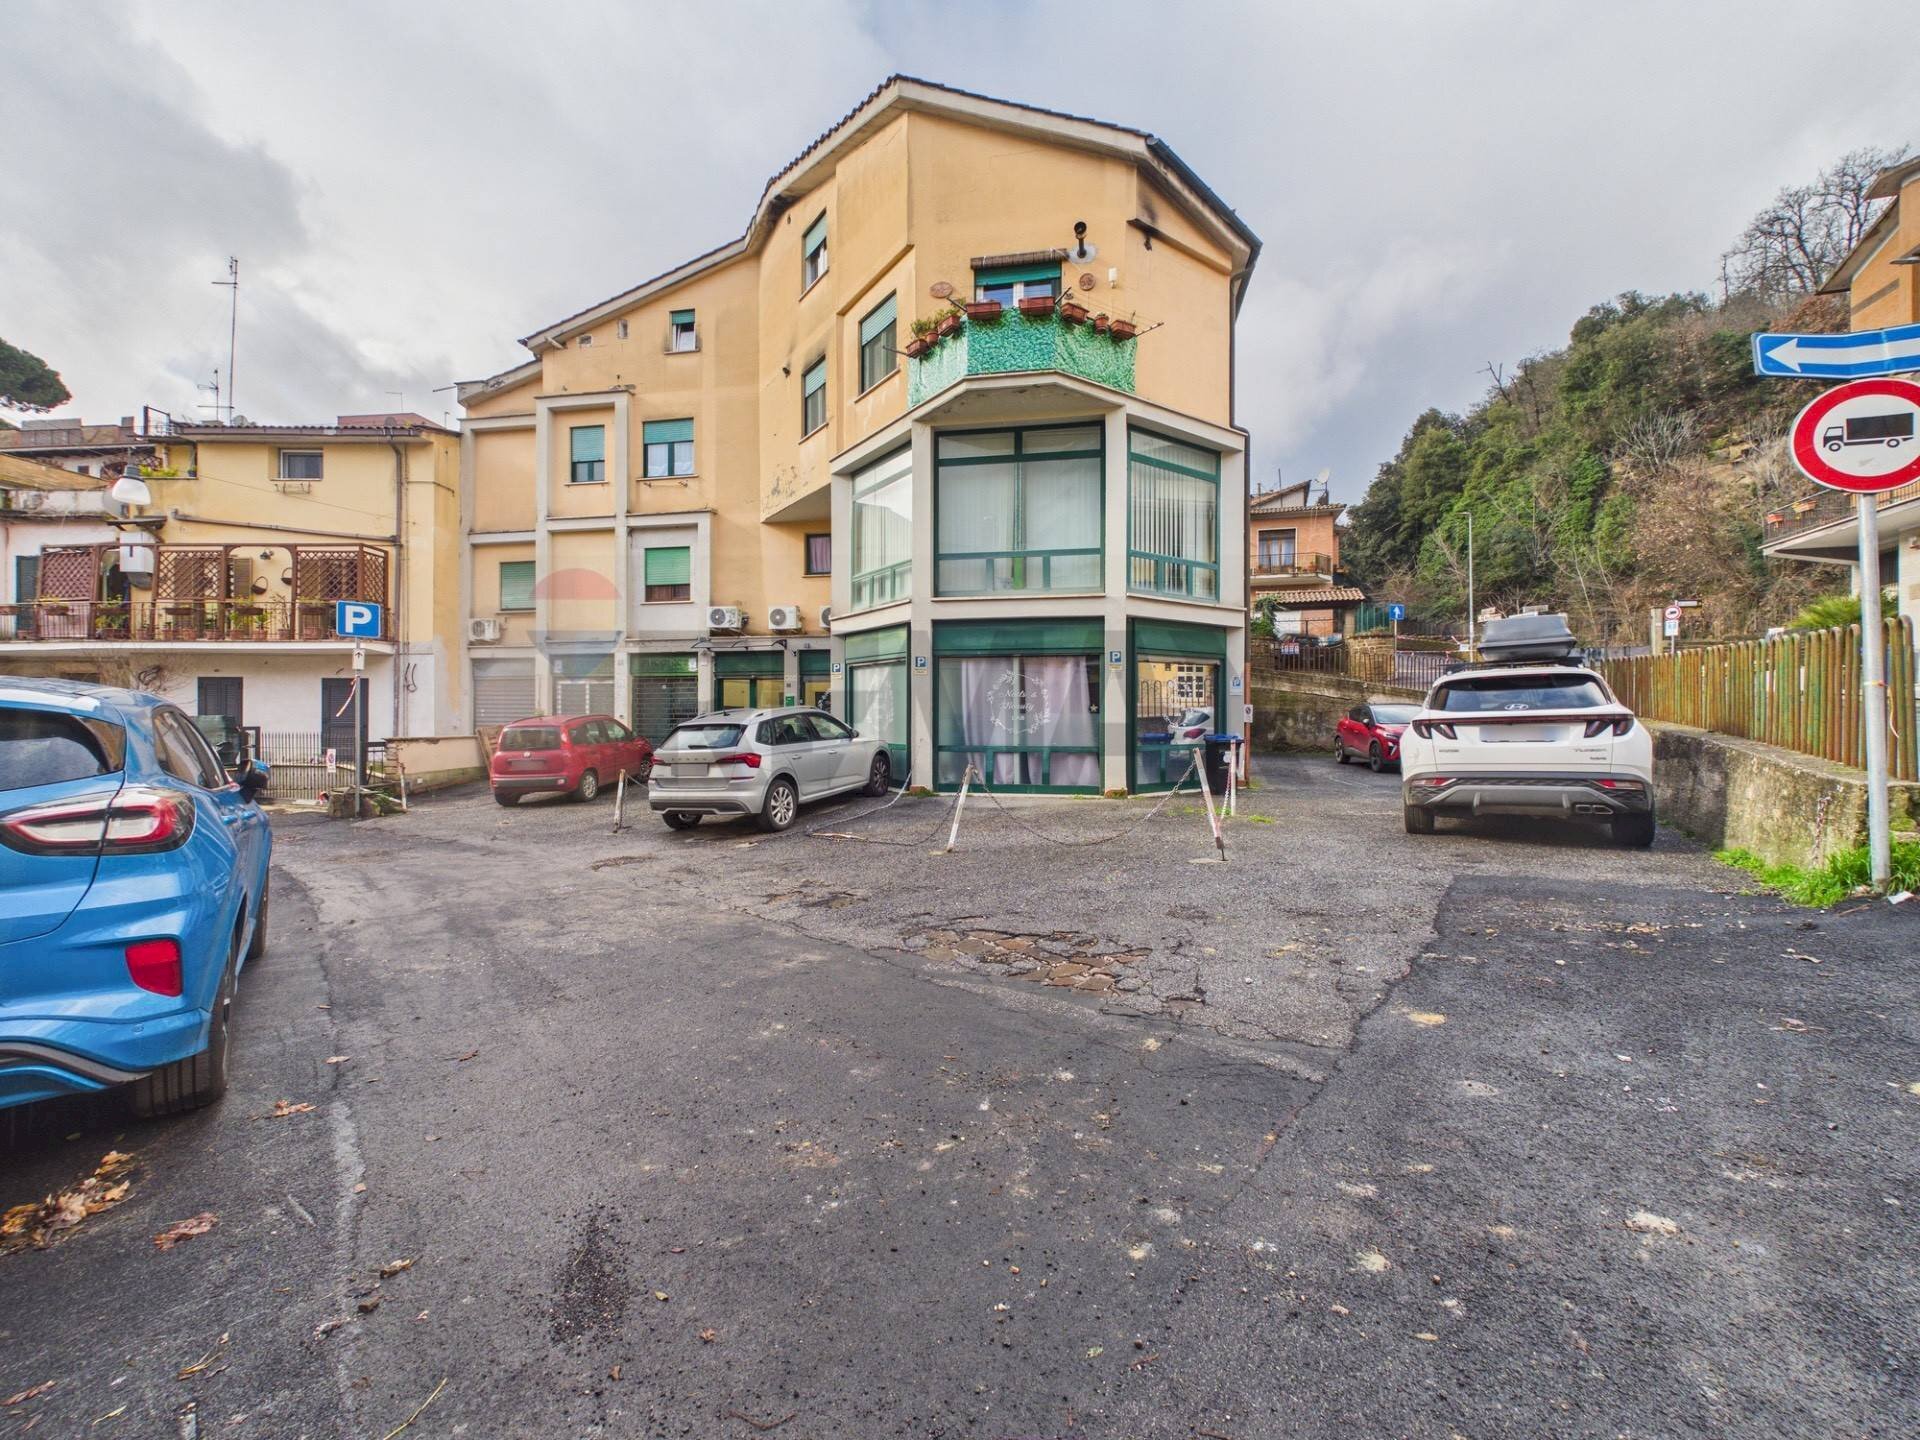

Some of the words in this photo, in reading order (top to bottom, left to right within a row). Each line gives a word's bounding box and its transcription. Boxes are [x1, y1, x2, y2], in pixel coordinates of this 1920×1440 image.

[345, 605, 372, 633] P
[917, 657, 925, 667] P
[1112, 652, 1120, 663] P
[833, 663, 840, 672] P
